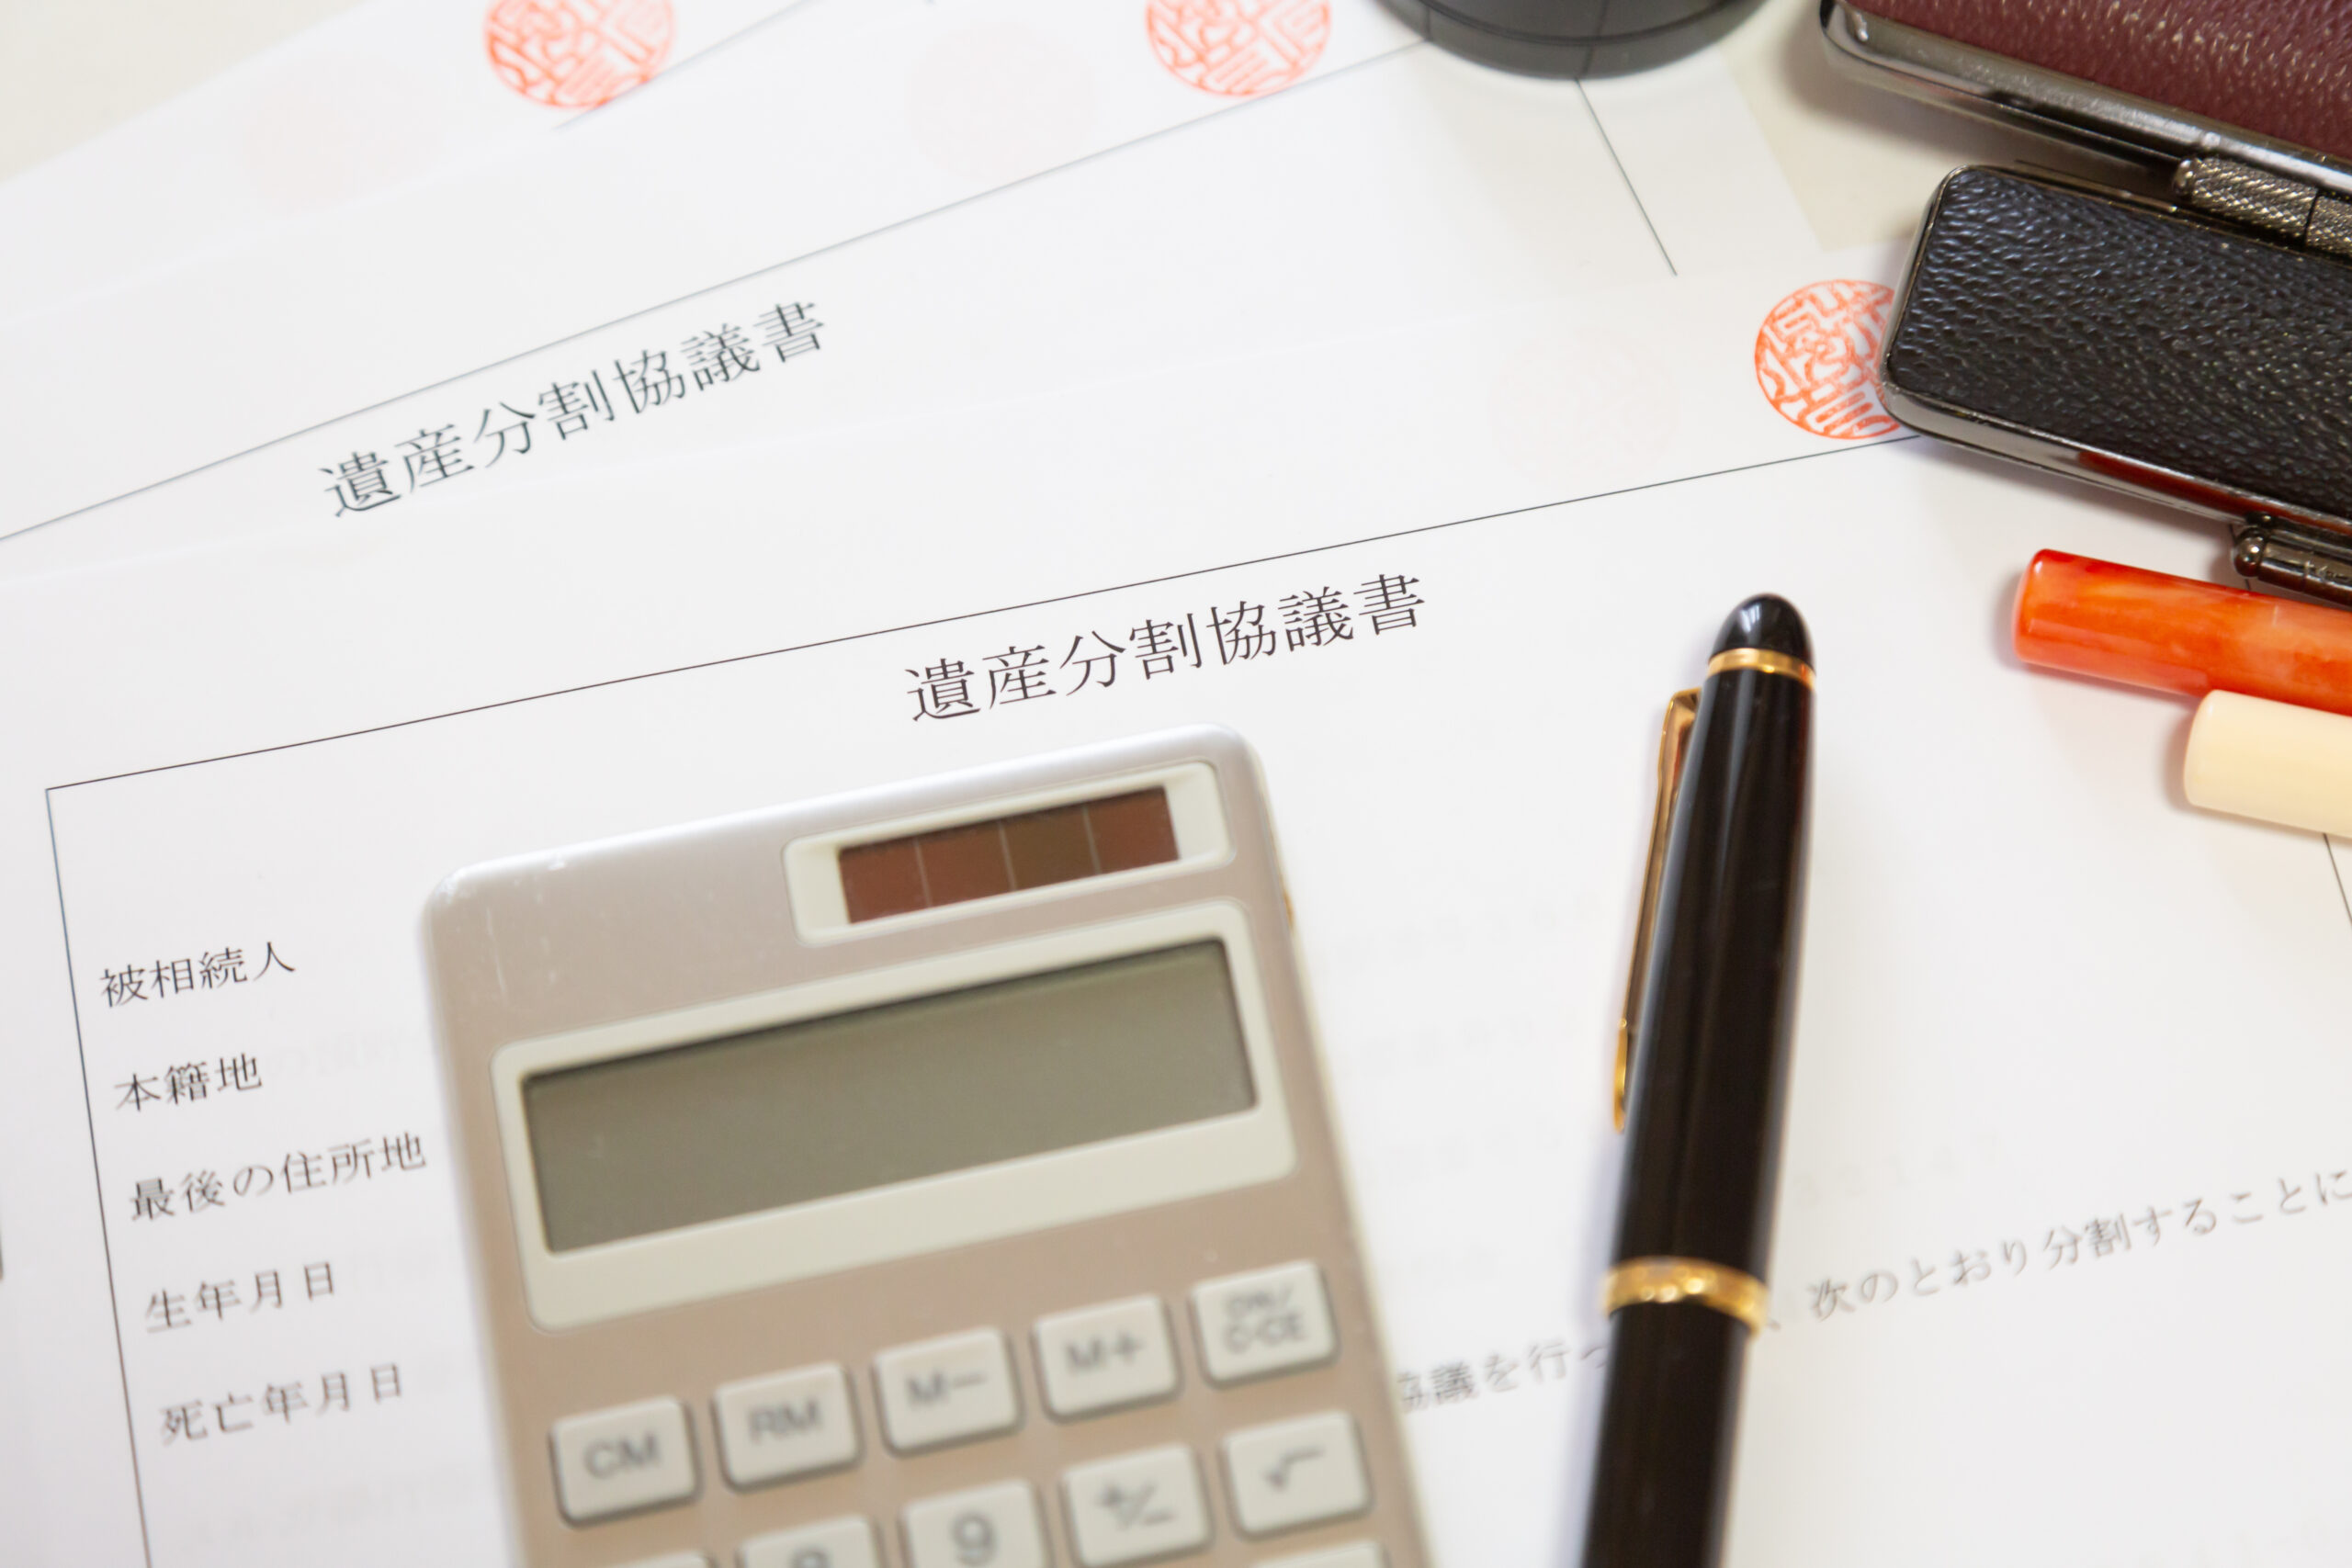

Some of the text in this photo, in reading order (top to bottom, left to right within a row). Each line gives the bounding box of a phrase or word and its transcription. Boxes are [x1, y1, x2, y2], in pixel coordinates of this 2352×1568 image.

[317, 299, 826, 518] 遺産分割協議書
[904, 573, 1426, 722] 遺産分割協議書
[100, 941, 297, 1009] 被相続人
[114, 1053, 265, 1112] 本籍地
[129, 1131, 428, 1223] 最後の住所地
[143, 1260, 337, 1335] 生年月日
[158, 1361, 404, 1448] 死亡年月日
[748, 1397, 821, 1445] RM
[582, 1431, 661, 1481] CM
[950, 1512, 999, 1568] 9
